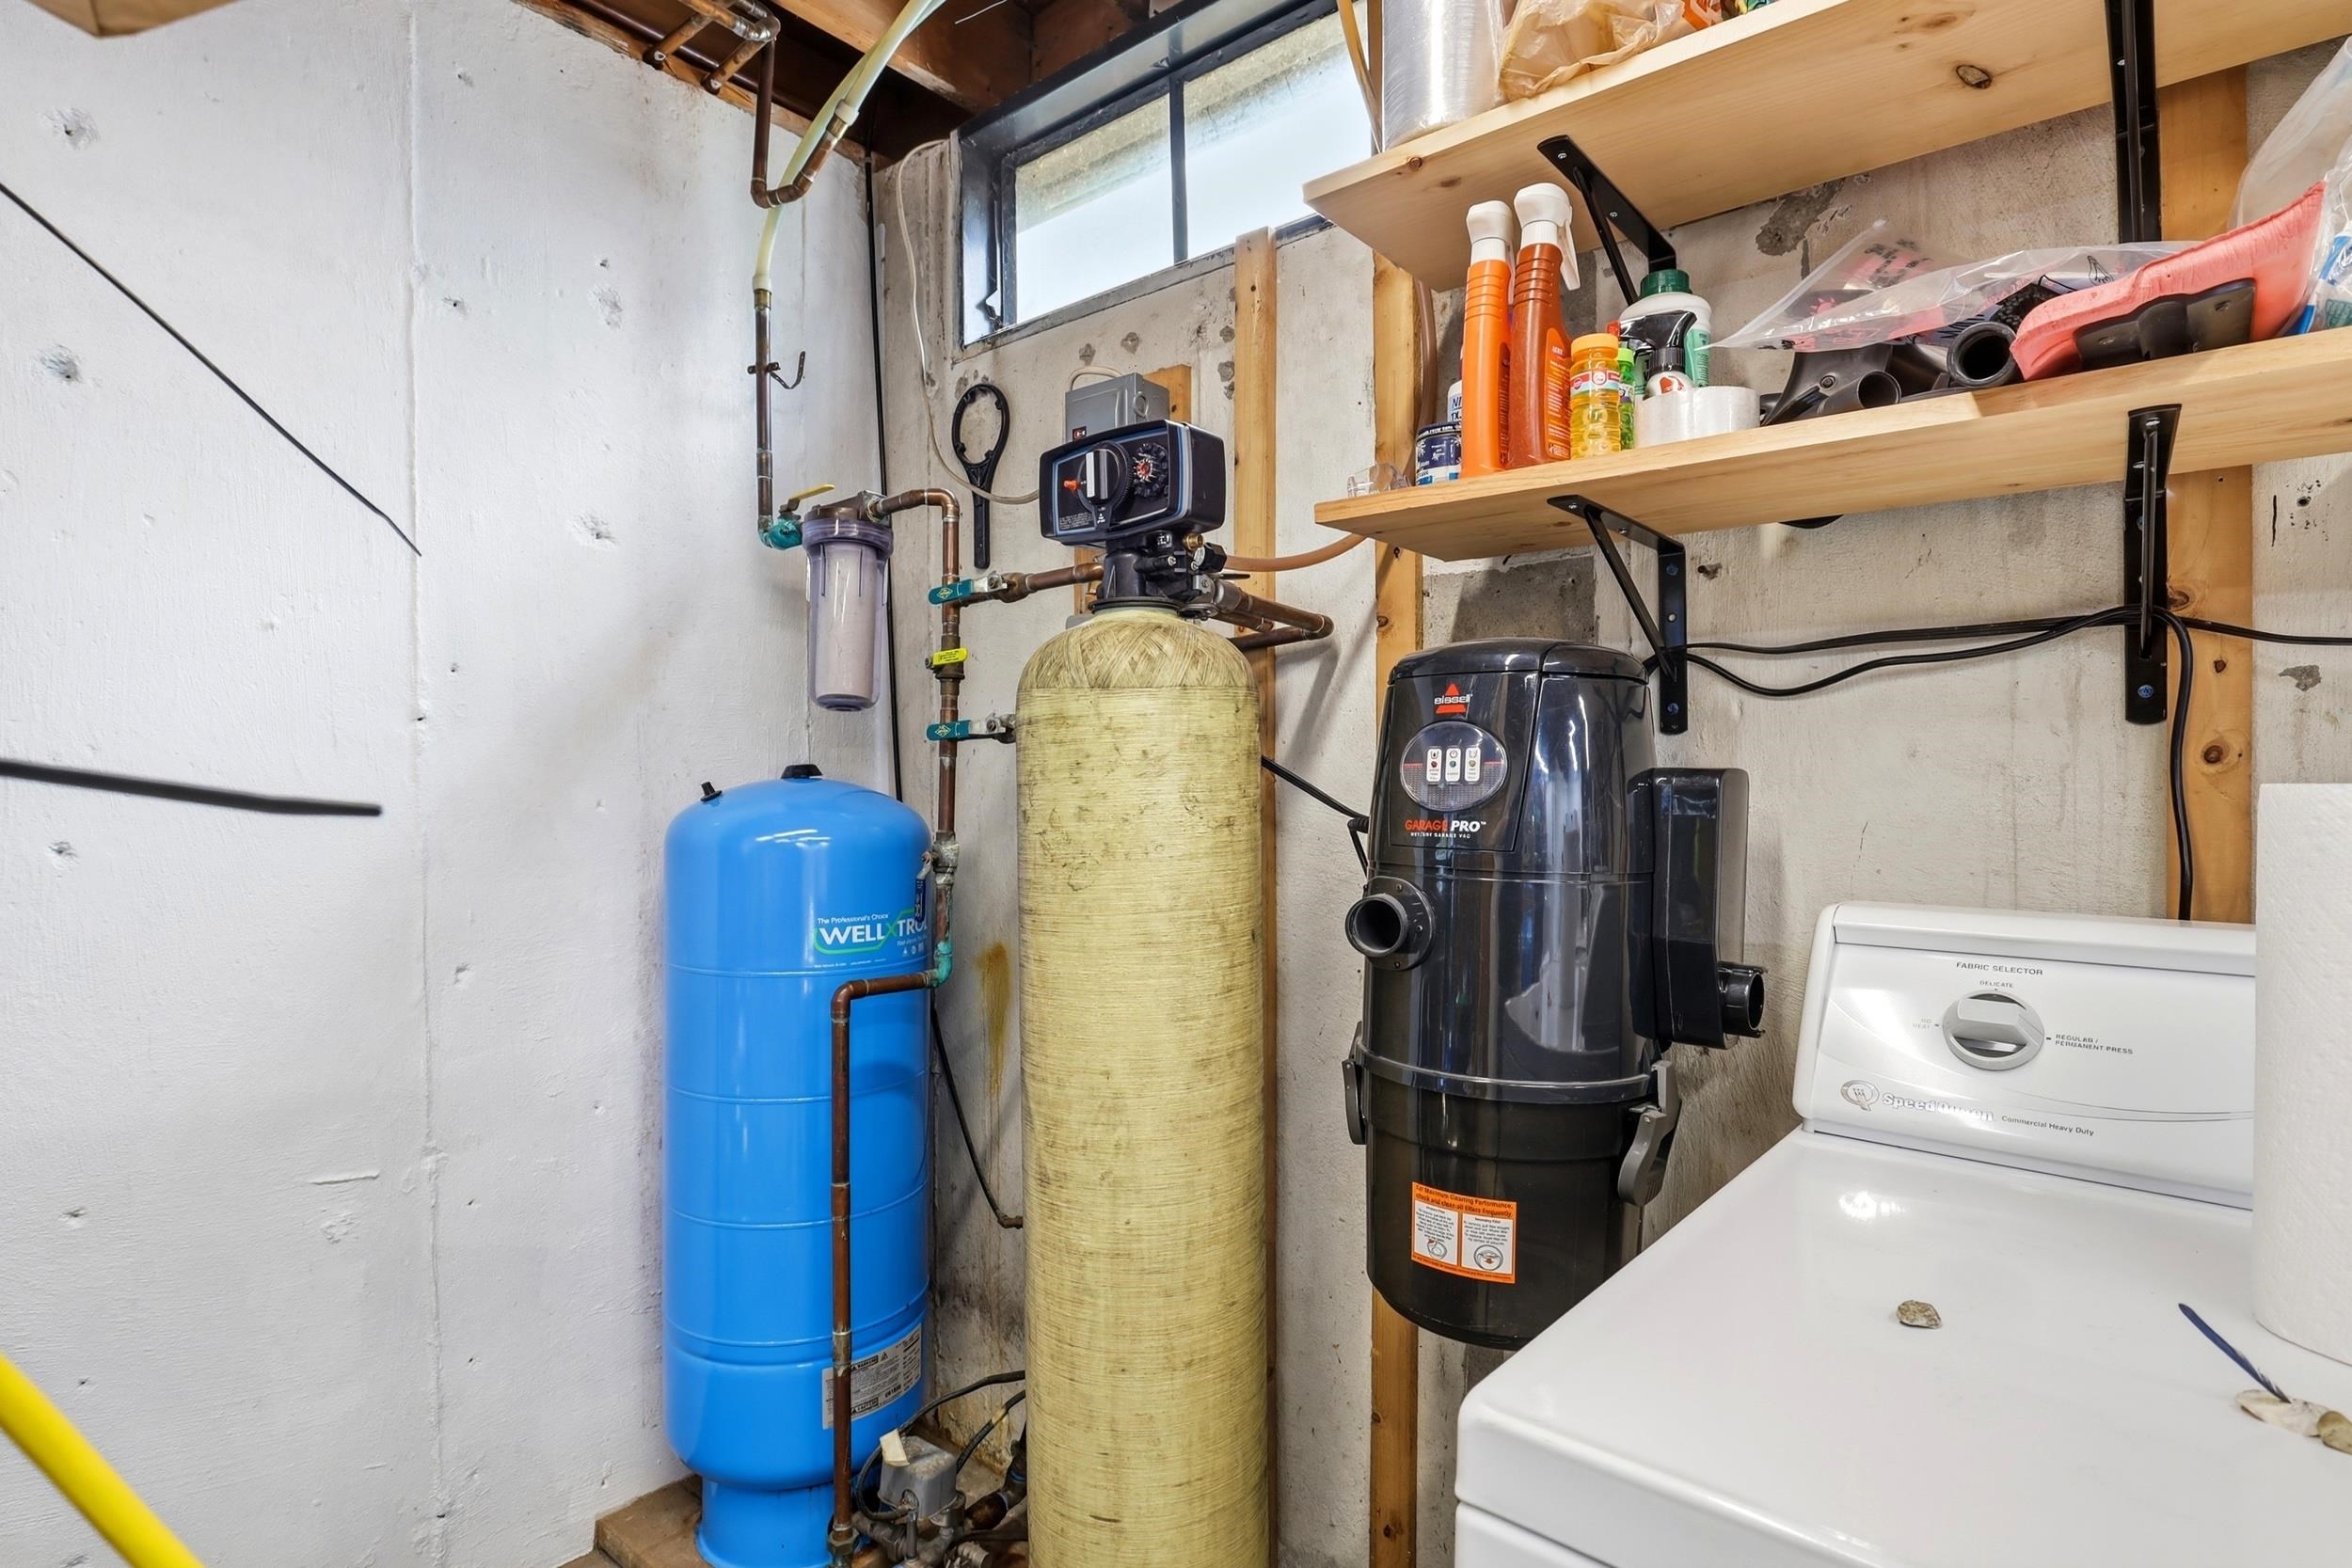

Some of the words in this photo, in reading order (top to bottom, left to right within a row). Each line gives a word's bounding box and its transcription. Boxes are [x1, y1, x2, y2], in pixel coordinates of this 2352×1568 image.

[1405, 819, 1448, 832] GARAGE
[1956, 961, 1990, 971] FABRIC
[1992, 965, 2043, 975] SELECTOR
[2056, 1034, 2094, 1043] REGULAR
[2055, 1040, 2104, 1051] PERMANENT
[2106, 1046, 2134, 1054] PRESS
[1883, 1093, 1936, 1112] Speed
[2001, 1115, 2047, 1129] Commercial
[2048, 1122, 2074, 1133] Heavy
[2075, 1126, 2095, 1137] Duty
